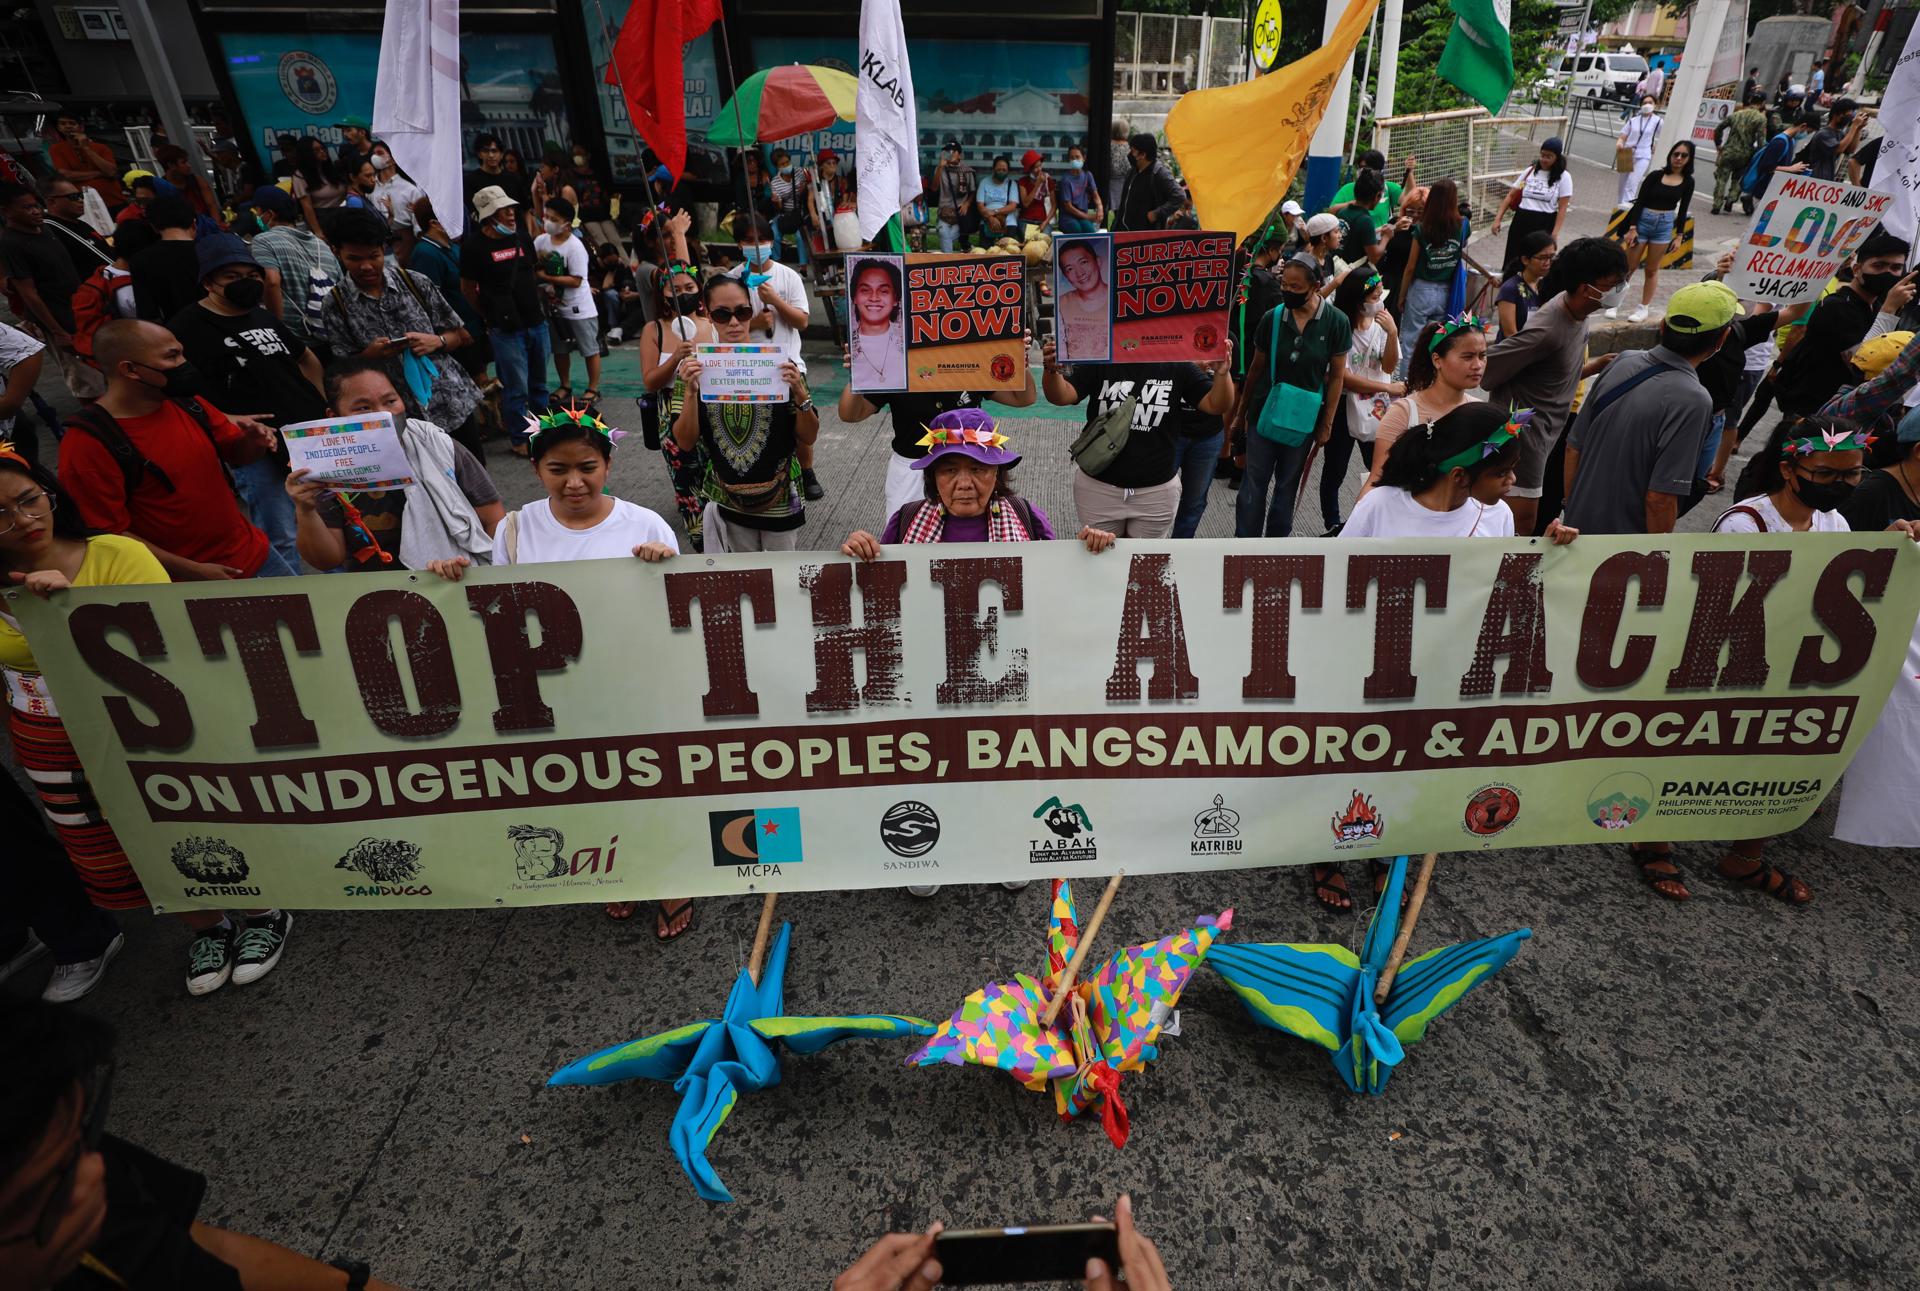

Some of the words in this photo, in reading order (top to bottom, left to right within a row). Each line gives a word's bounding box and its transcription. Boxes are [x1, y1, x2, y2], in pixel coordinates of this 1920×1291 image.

[1779, 178, 1843, 205] MARCOS
[1841, 190, 1867, 208] AND
[1864, 195, 1891, 212] SMC
[1748, 199, 1863, 258] LOVE
[1116, 237, 1232, 266] SURFACE
[908, 261, 1022, 288] SURFACE
[1117, 258, 1229, 288] DEXTER
[910, 282, 1022, 313] BAZOO
[1116, 280, 1229, 318] NOW!
[911, 306, 1022, 344] NOW!
[704, 359, 722, 367] LOVE
[724, 359, 736, 367] THE
[725, 368, 754, 377] SURFACE
[710, 377, 736, 386] DEXTER
[736, 377, 750, 386] AND
[321, 436, 341, 447] LOVE
[342, 435, 356, 445] THE
[334, 457, 355, 468] FREE
[68, 580, 585, 754] STOP
[663, 556, 1030, 717] THE
[1105, 547, 1899, 701] ATTACKS
[143, 773, 243, 813] ON
[248, 747, 662, 814] INDIGENOUS
[678, 731, 951, 785] PEOPLES,
[966, 724, 1405, 770] BANGSAMORO,
[1422, 721, 1465, 759] &
[1478, 705, 1849, 759] ADVOCATES!
[1660, 778, 1822, 797] PANAGHIUSA
[1658, 799, 1712, 807] PHILIPPINE
[1714, 799, 1765, 807] NETWORK
[1767, 798, 1781, 806] TO
[1782, 793, 1818, 805] UPHOLD
[1656, 807, 1718, 816] INDIGENOUS
[1767, 804, 1799, 815] RIGHTS
[1029, 837, 1096, 850] TABAK
[1190, 839, 1243, 852] KATRIBU
[736, 864, 782, 878] MCPA
[883, 859, 940, 871] SANDIWA
[184, 885, 262, 898] KATRIBU
[343, 884, 433, 897] SANDUGO
